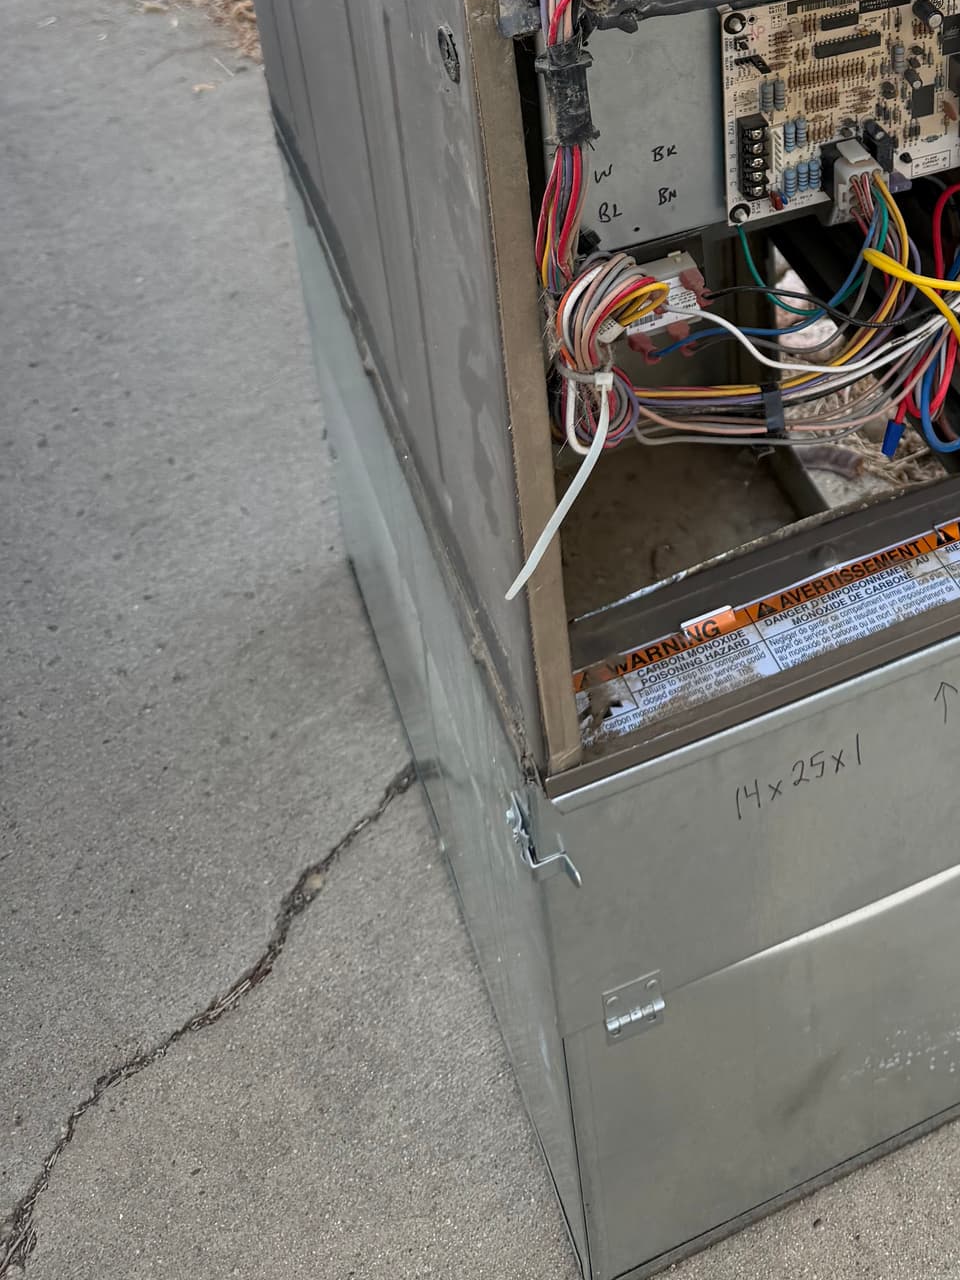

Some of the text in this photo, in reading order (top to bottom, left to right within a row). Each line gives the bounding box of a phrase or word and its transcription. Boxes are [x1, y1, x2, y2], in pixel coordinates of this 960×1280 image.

[594, 163, 613, 184] W
[651, 144, 678, 162] BK
[598, 201, 623, 223] BL
[658, 186, 677, 206] BN
[764, 555, 929, 626] DANGER D'EMPOISONNEMENT AU
[778, 541, 923, 607] AVERTISSEMENT
[791, 570, 914, 625] MONOXIDE DE CARBONE
[606, 620, 721, 676] WARNING
[636, 629, 746, 677] CARBON MONOXIDE
[638, 645, 760, 698] Failure to keep this compartment
[640, 637, 750, 686] POISONING HAZARD
[642, 691, 667, 705] closed
[745, 651, 766, 664] could
[604, 714, 632, 730] carbon
